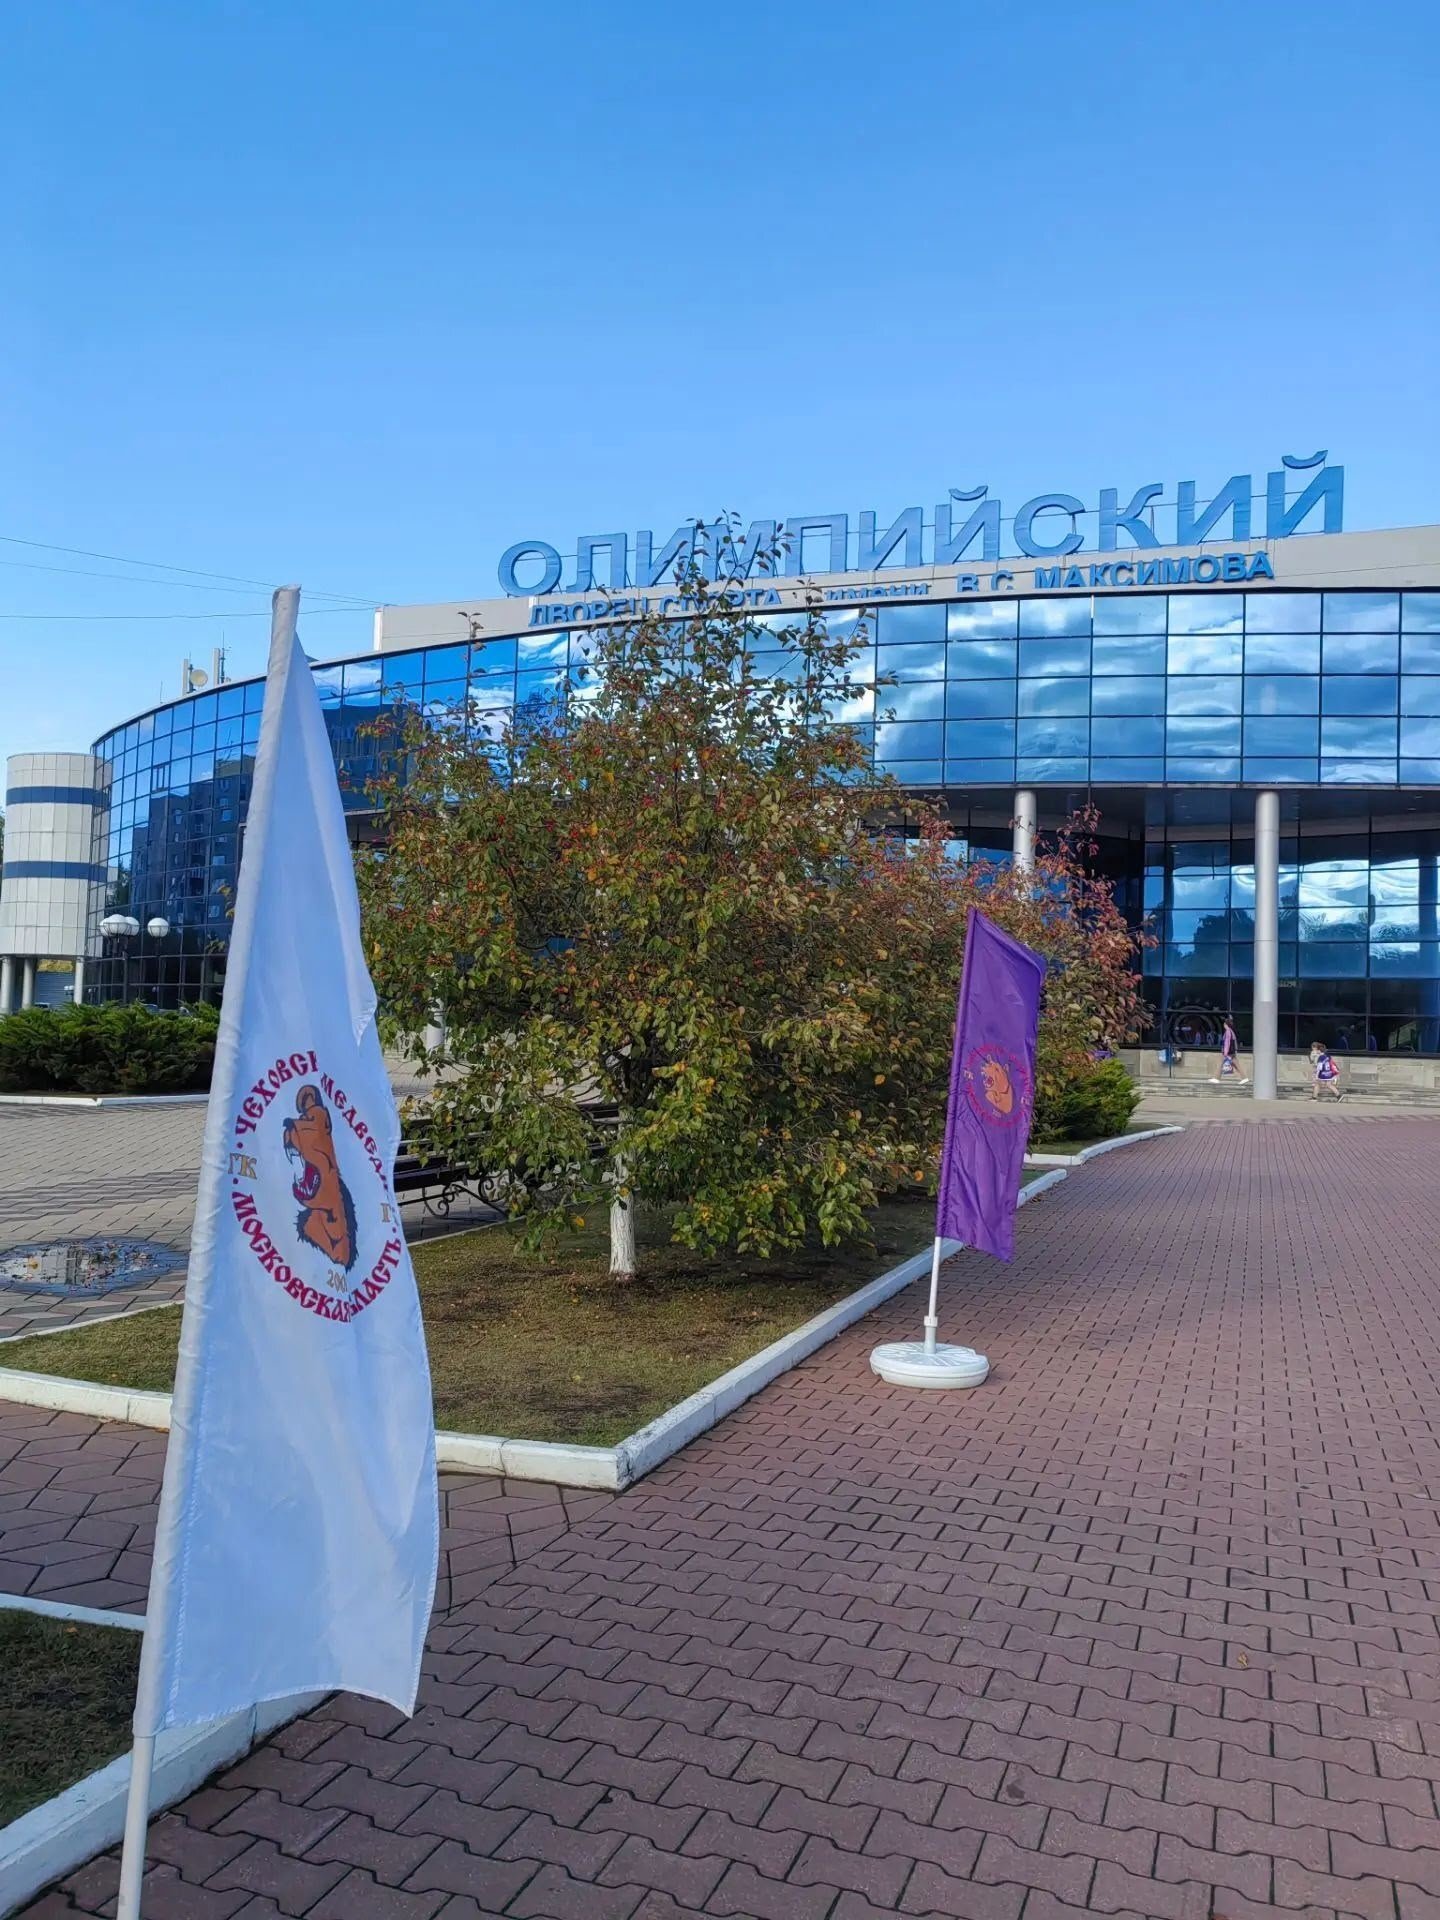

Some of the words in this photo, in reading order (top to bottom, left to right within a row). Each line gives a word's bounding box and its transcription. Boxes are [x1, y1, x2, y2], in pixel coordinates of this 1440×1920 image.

[498, 450, 1344, 597] ОЛИМПИЙСКИЙ
[1034, 550, 1275, 589] МАКСИМОВА
[320, 1072, 390, 1191] МЕДВЕД
